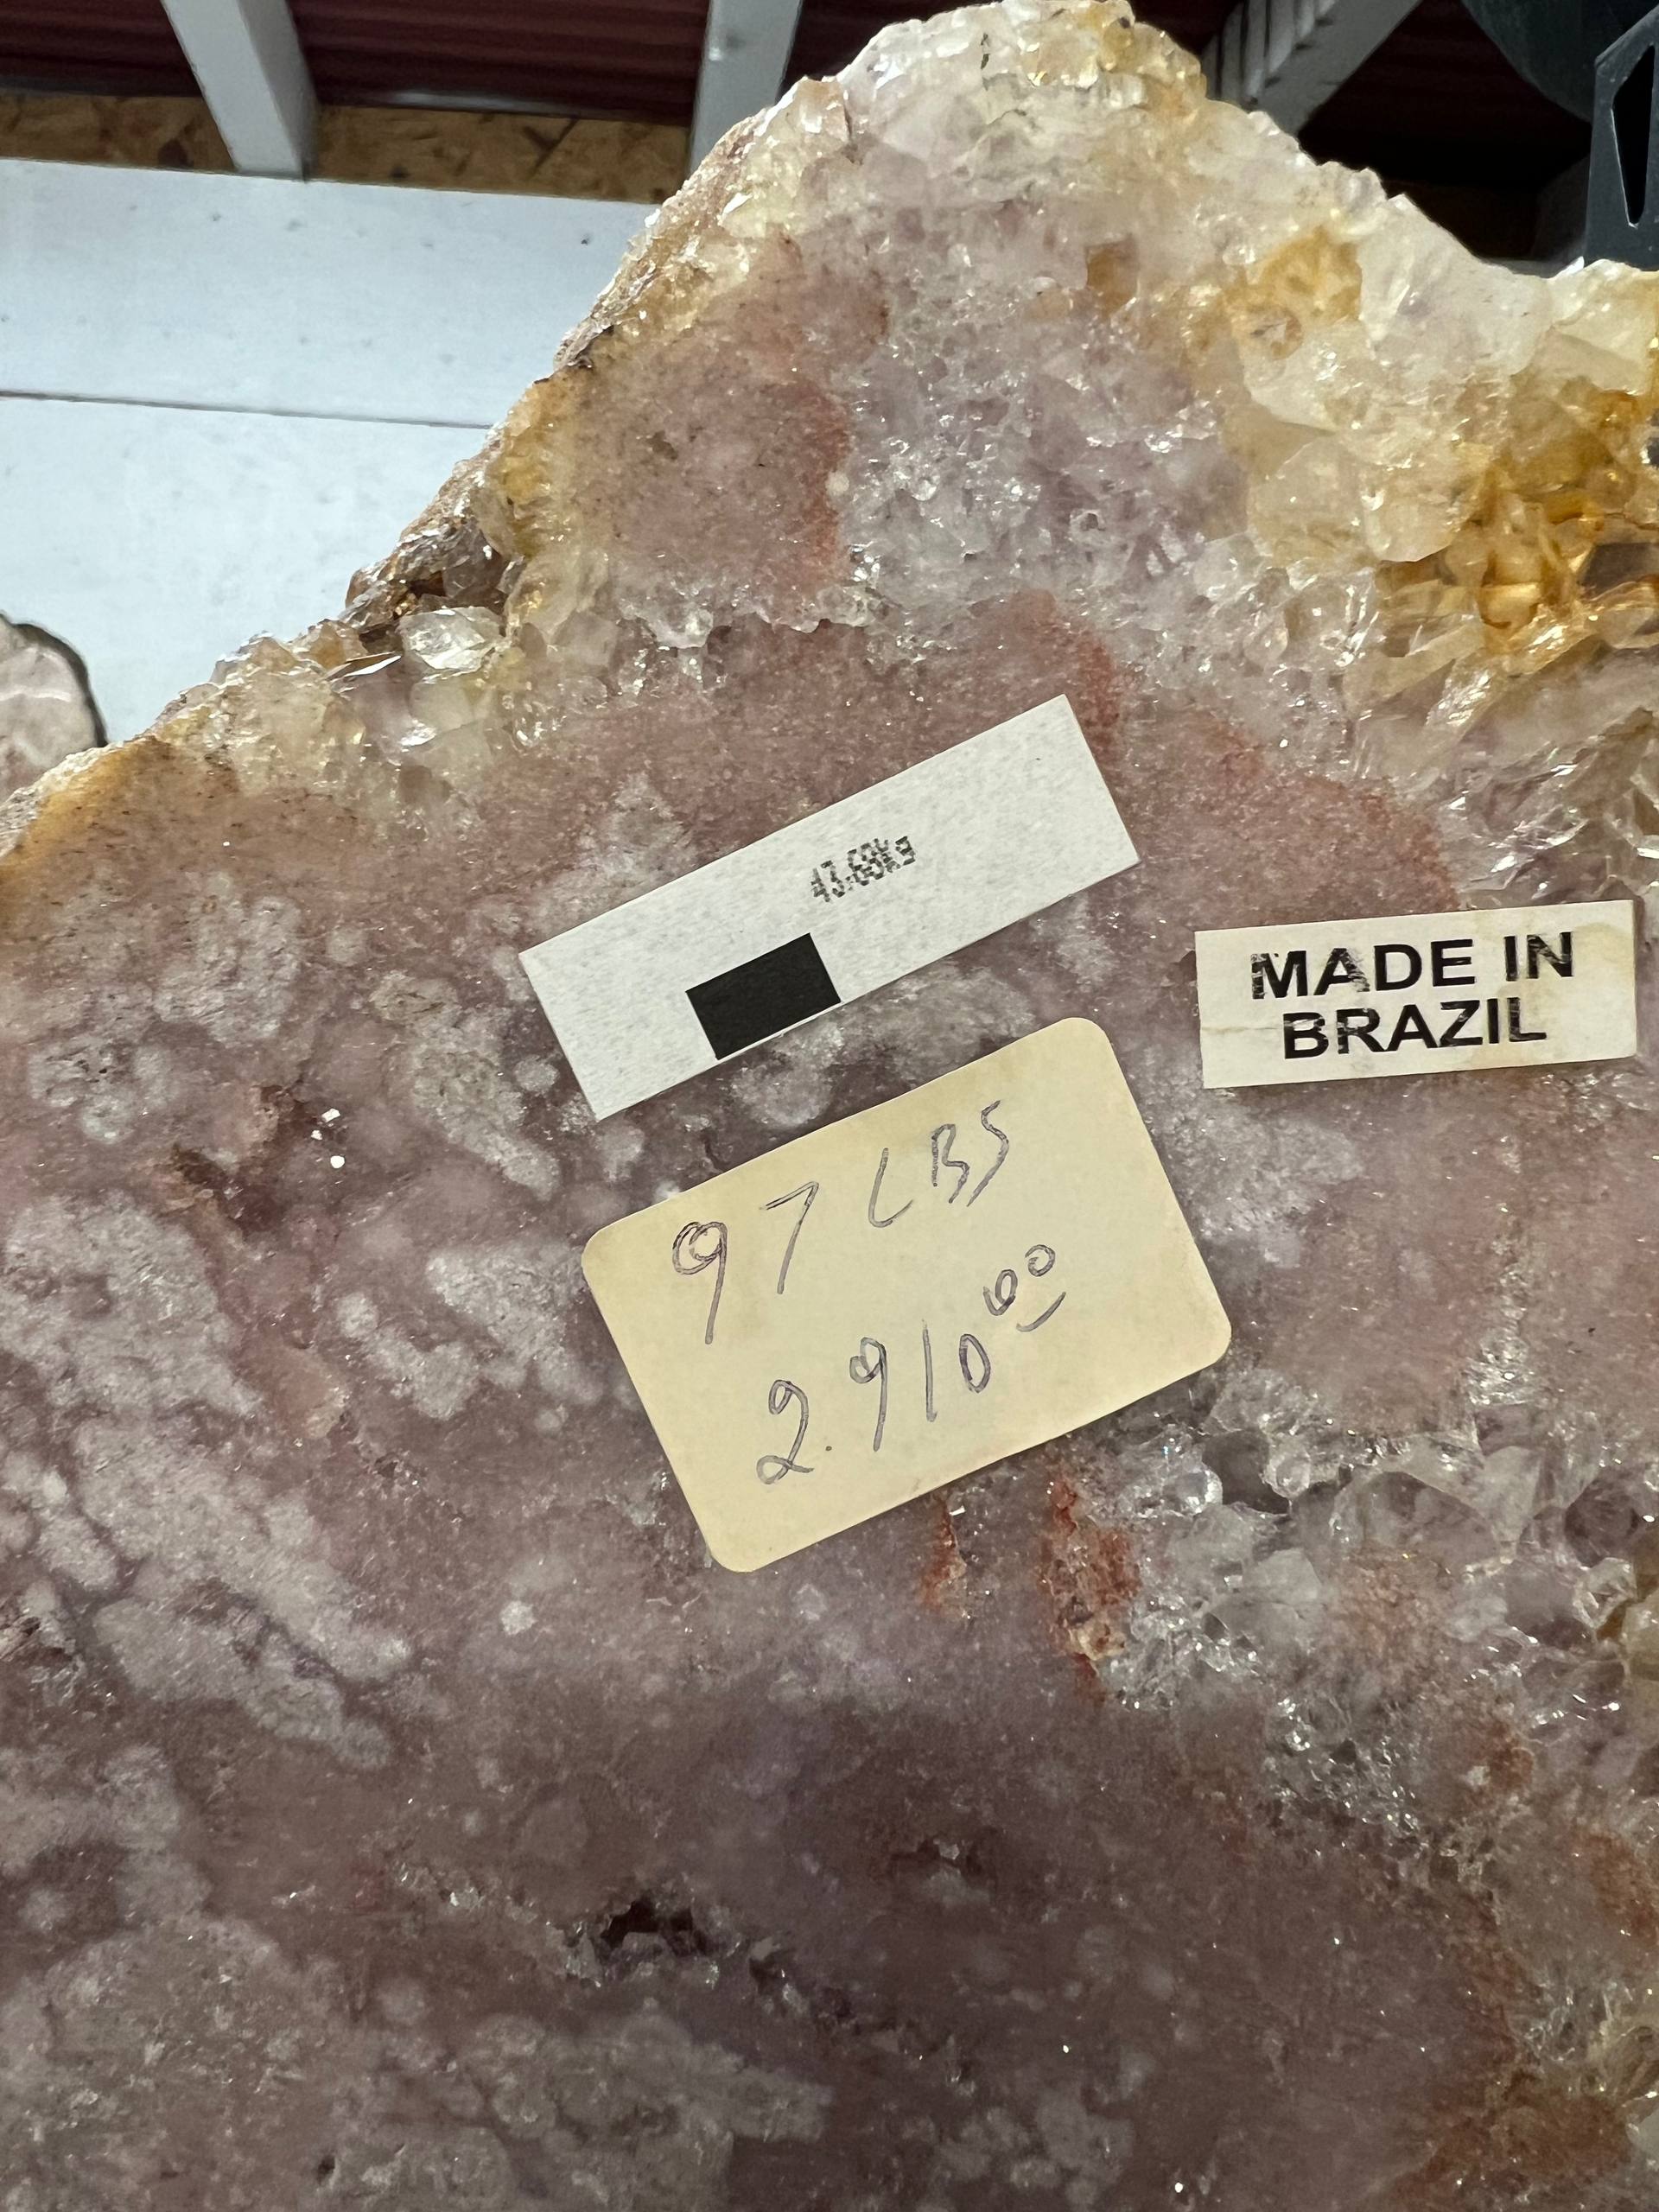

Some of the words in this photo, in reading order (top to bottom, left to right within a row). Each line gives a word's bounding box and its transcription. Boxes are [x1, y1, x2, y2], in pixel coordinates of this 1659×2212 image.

[1250, 939, 1477, 1000] MADE
[1503, 931, 1574, 982] IN
[1282, 996, 1548, 1059] BRAZIL
[672, 1181, 819, 1345] 97
[868, 1099, 1010, 1228] LBS
